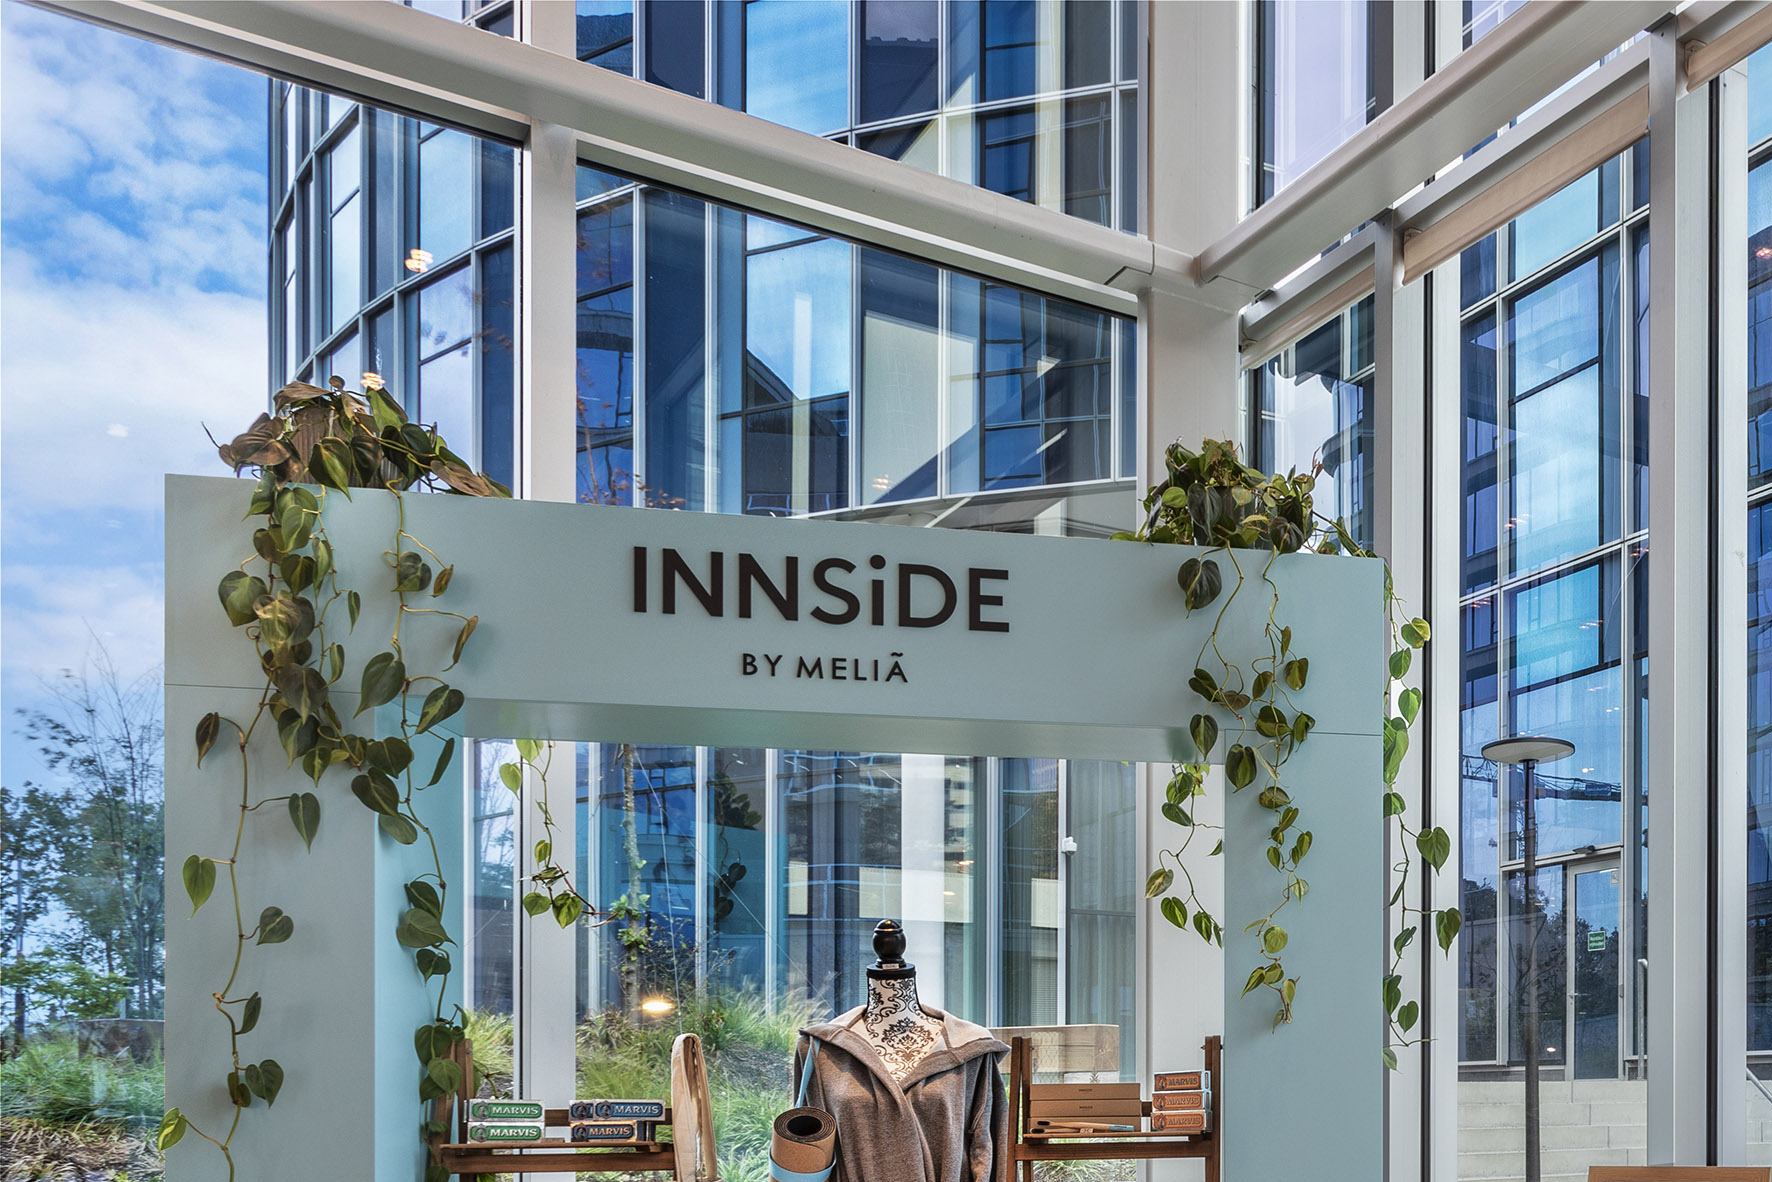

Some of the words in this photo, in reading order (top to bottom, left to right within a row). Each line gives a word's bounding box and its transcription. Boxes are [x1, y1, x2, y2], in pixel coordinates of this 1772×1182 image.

[633, 546, 1010, 633] INNSiDE
[742, 652, 783, 677] BY
[1168, 1077, 1198, 1086] MARVIS
[492, 1105, 539, 1115] MARVIS
[615, 1105, 659, 1114] MARVIS
[490, 1128, 538, 1138] MARVIS
[589, 1126, 631, 1137] MARVIS
